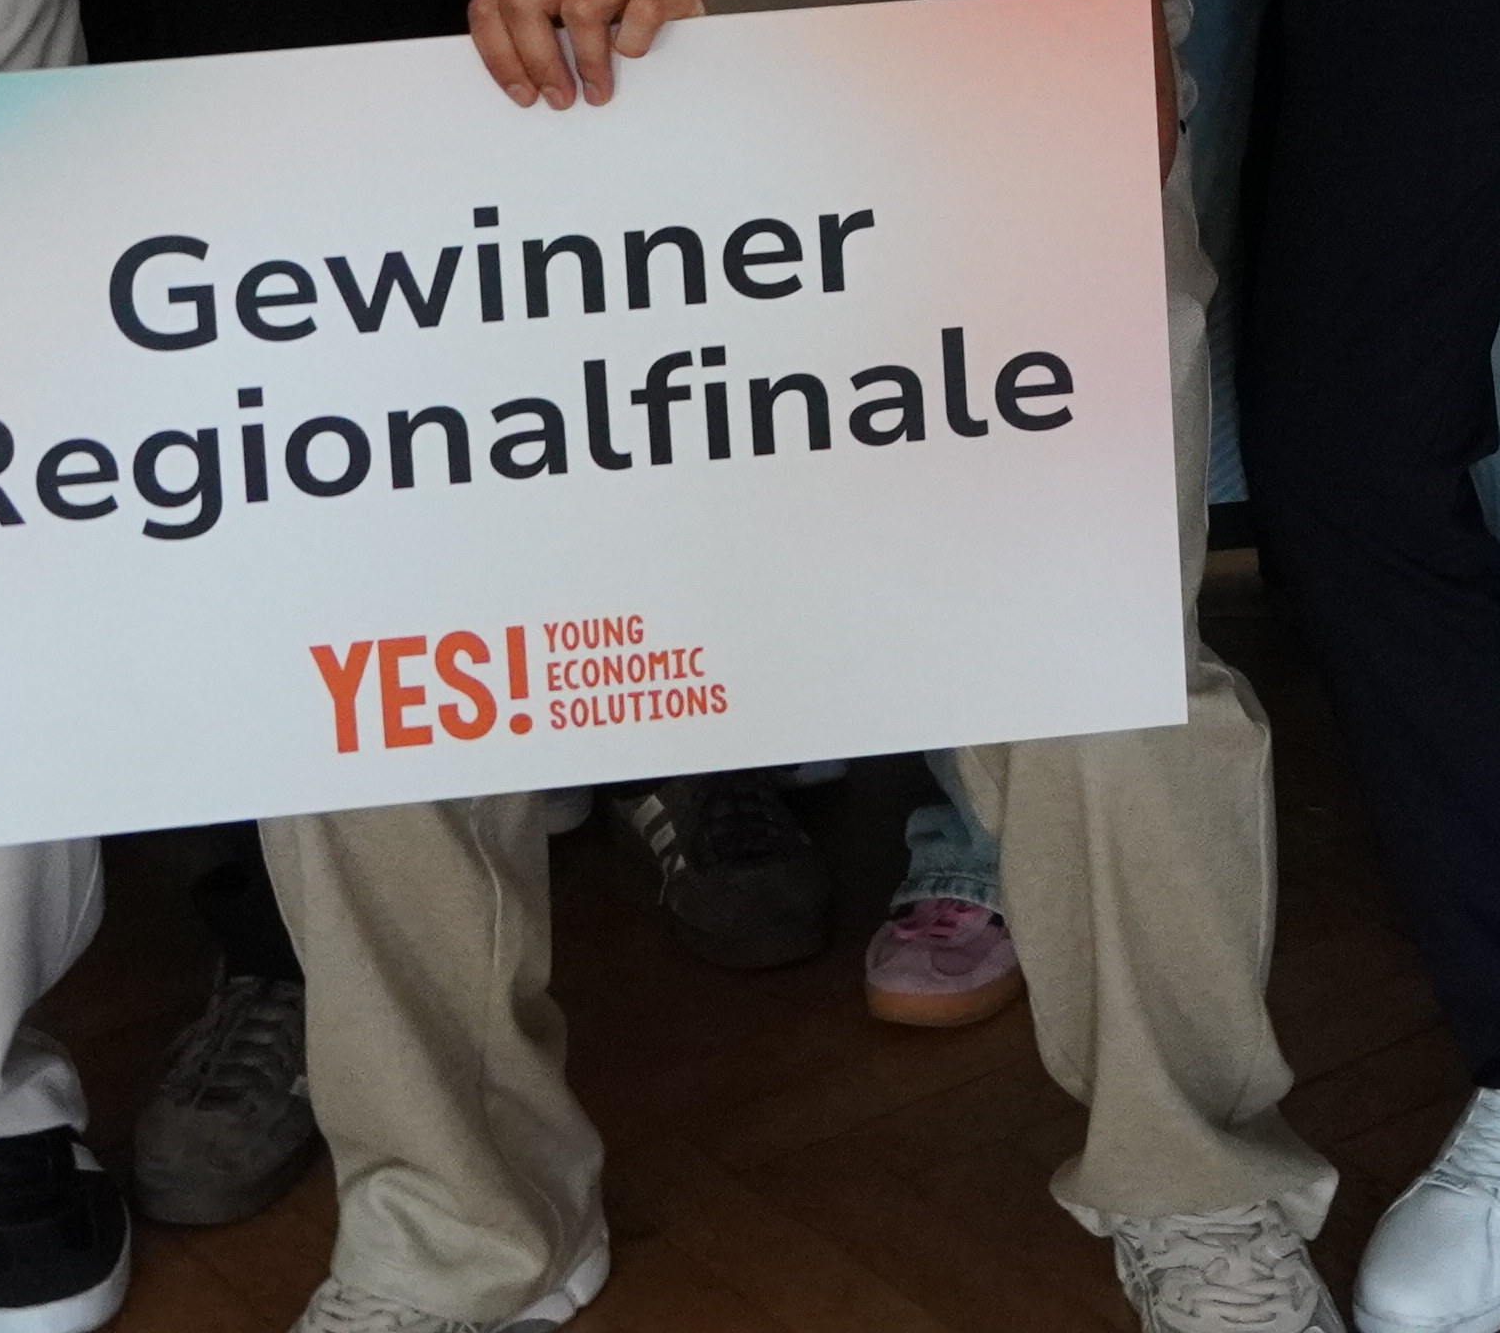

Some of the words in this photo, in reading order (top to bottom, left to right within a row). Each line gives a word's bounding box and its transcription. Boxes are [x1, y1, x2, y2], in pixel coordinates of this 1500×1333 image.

[108, 205, 876, 352] Gewinner
[543, 614, 645, 653] YOUNG
[309, 625, 534, 754] YES!
[546, 647, 706, 692] ECONOMIC
[549, 683, 729, 731] SOLUTIONS
